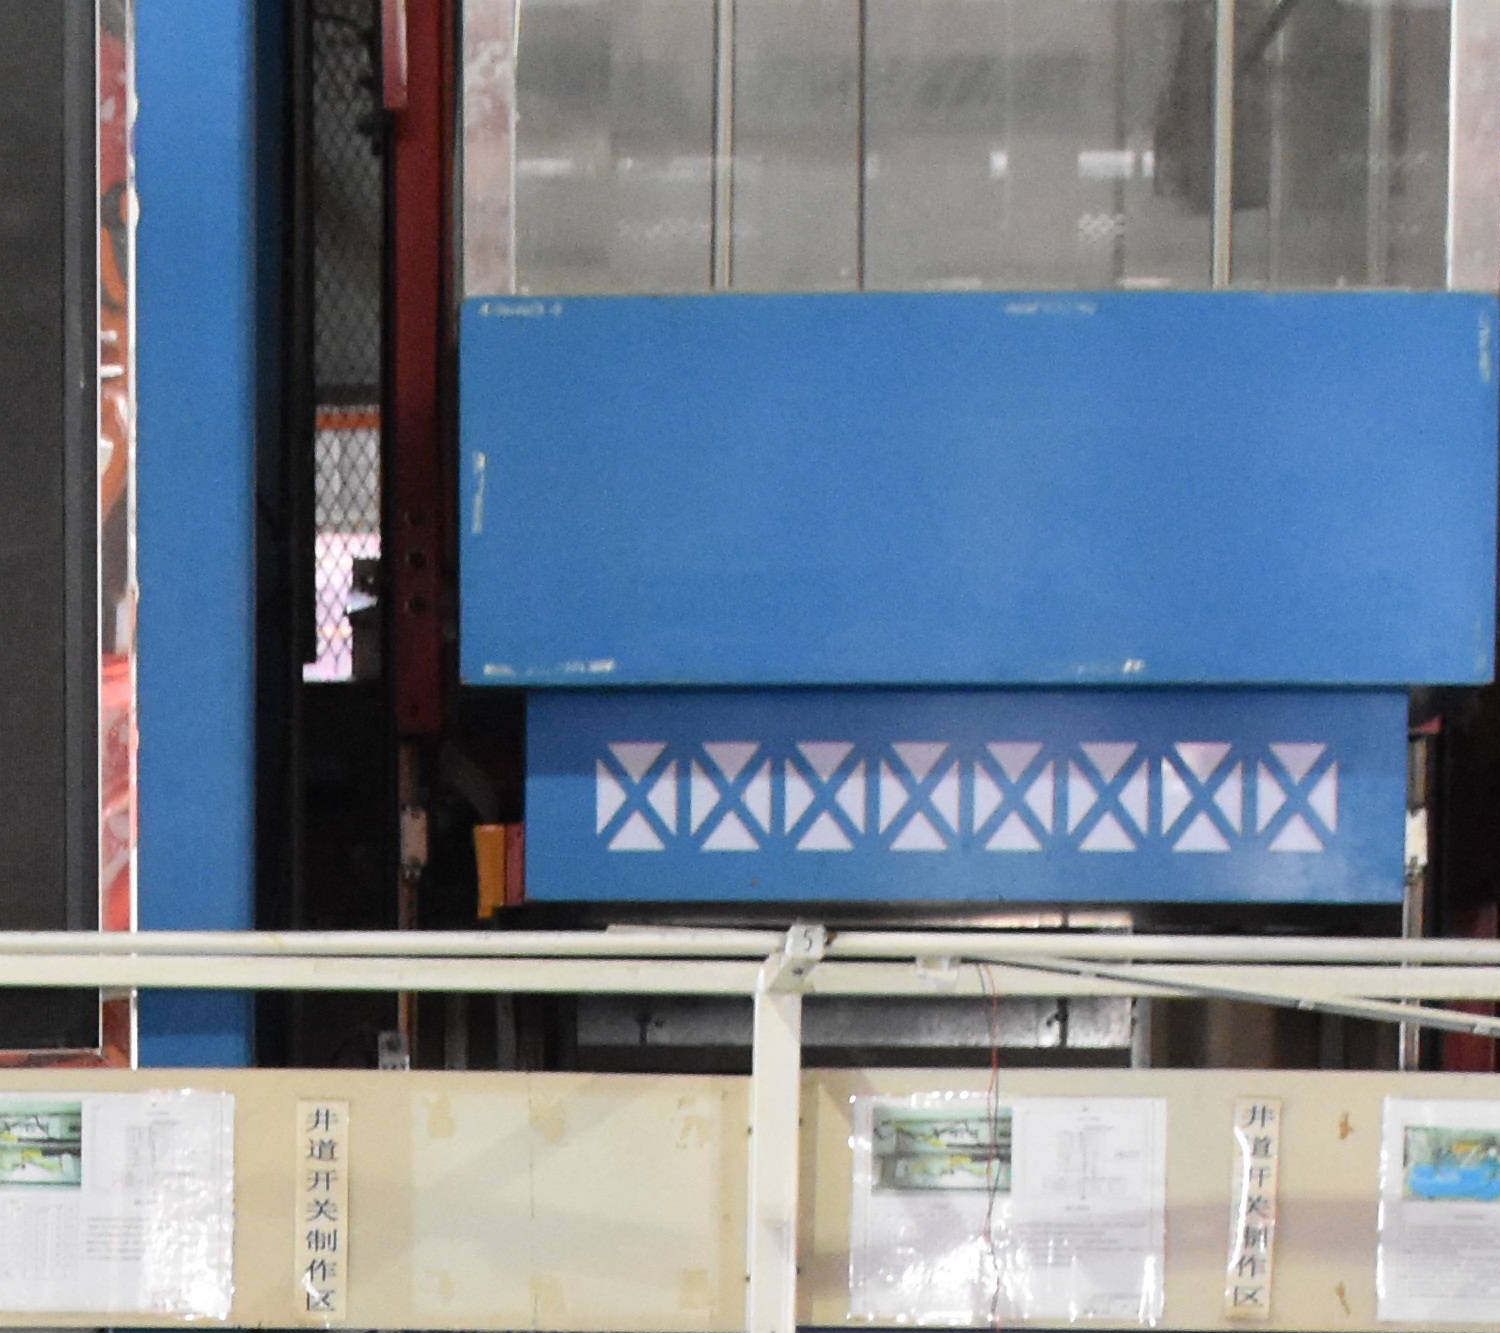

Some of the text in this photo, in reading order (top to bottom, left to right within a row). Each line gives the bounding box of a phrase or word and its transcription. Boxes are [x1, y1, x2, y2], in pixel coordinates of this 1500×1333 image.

[305, 1108, 338, 1312] 井道开关制作区
